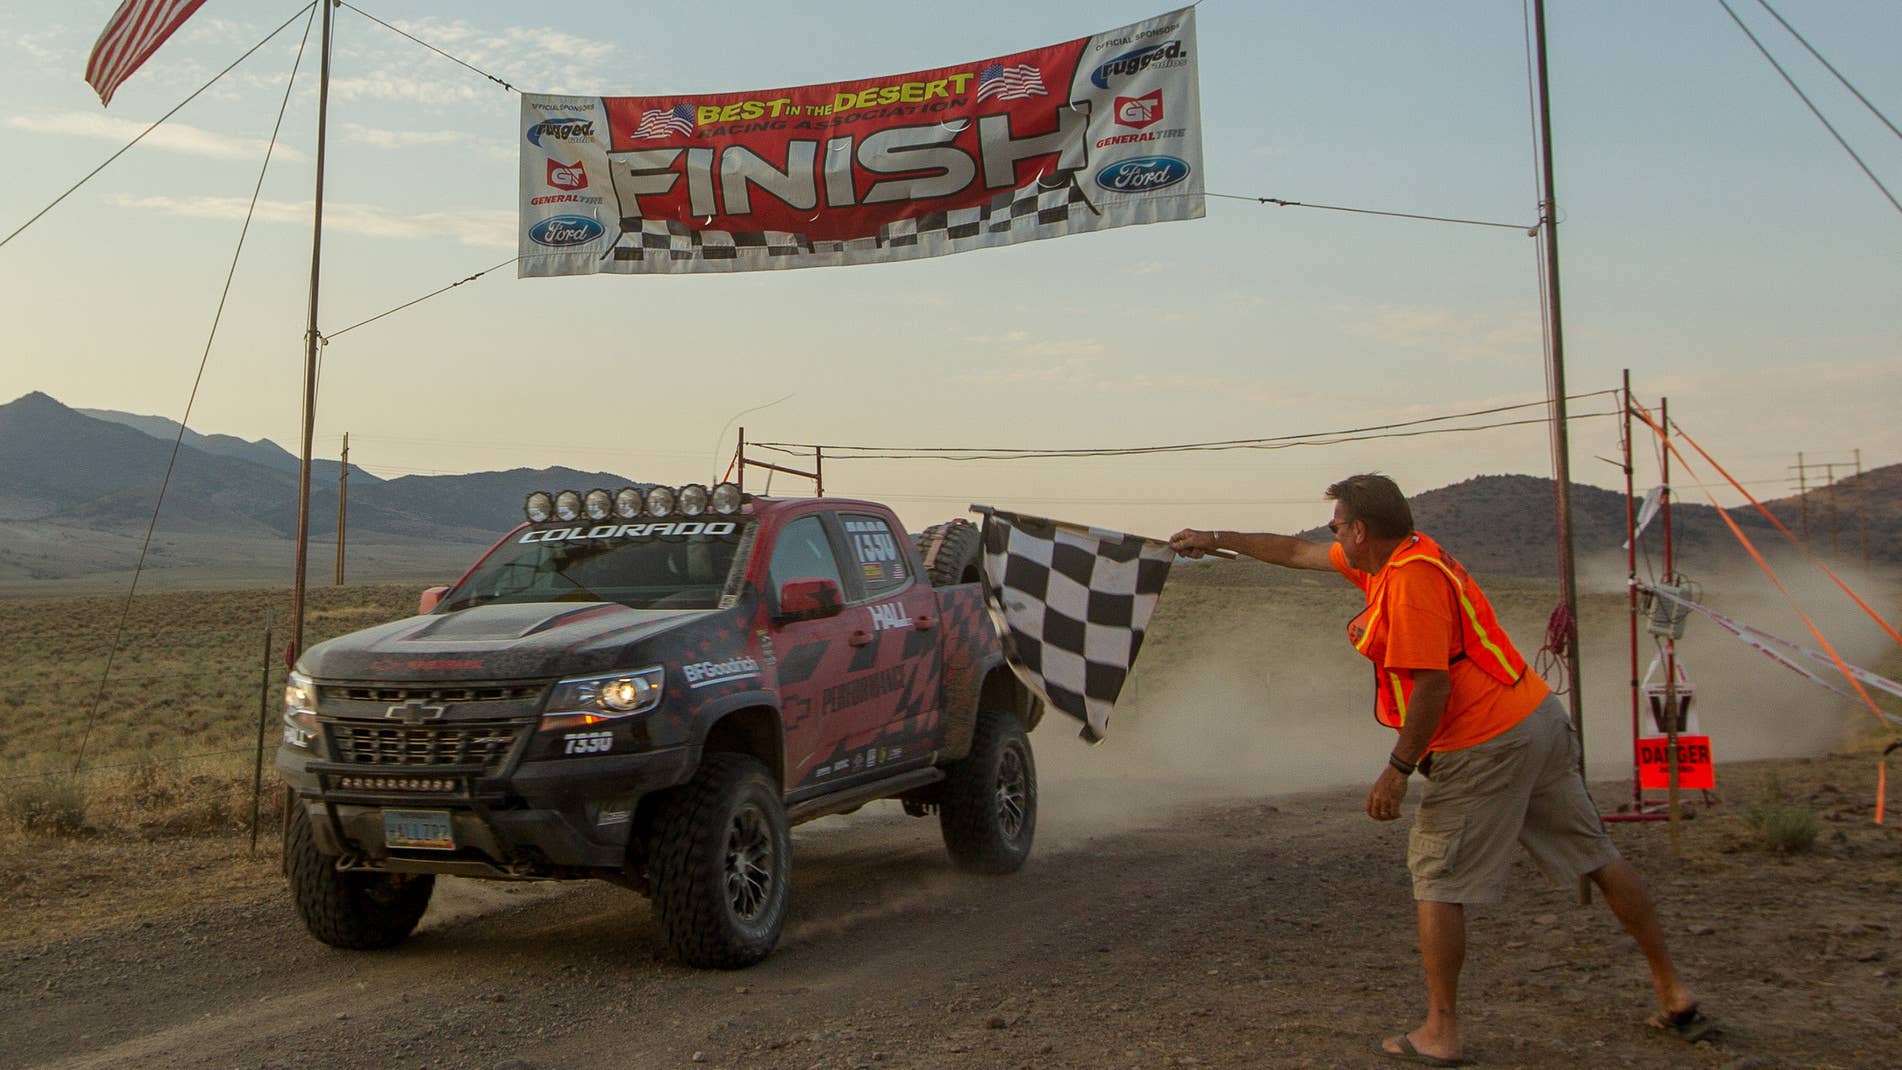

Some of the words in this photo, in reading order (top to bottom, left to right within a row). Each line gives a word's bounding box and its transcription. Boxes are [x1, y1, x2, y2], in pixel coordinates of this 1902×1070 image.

[1096, 37, 1134, 52] OFFICIAL
[697, 99, 791, 126] BEST
[785, 105, 801, 116] IN
[806, 104, 833, 117] THE
[833, 73, 974, 113] DESERT
[696, 120, 788, 138] RACING
[793, 99, 970, 131] ASSOCIATION
[608, 101, 1090, 219] FINISH
[1115, 162, 1171, 188] Ford
[545, 220, 589, 242] Ford
[518, 522, 736, 544] COLORADO
[866, 601, 914, 630] HALL
[683, 656, 759, 682] BFGoodrich
